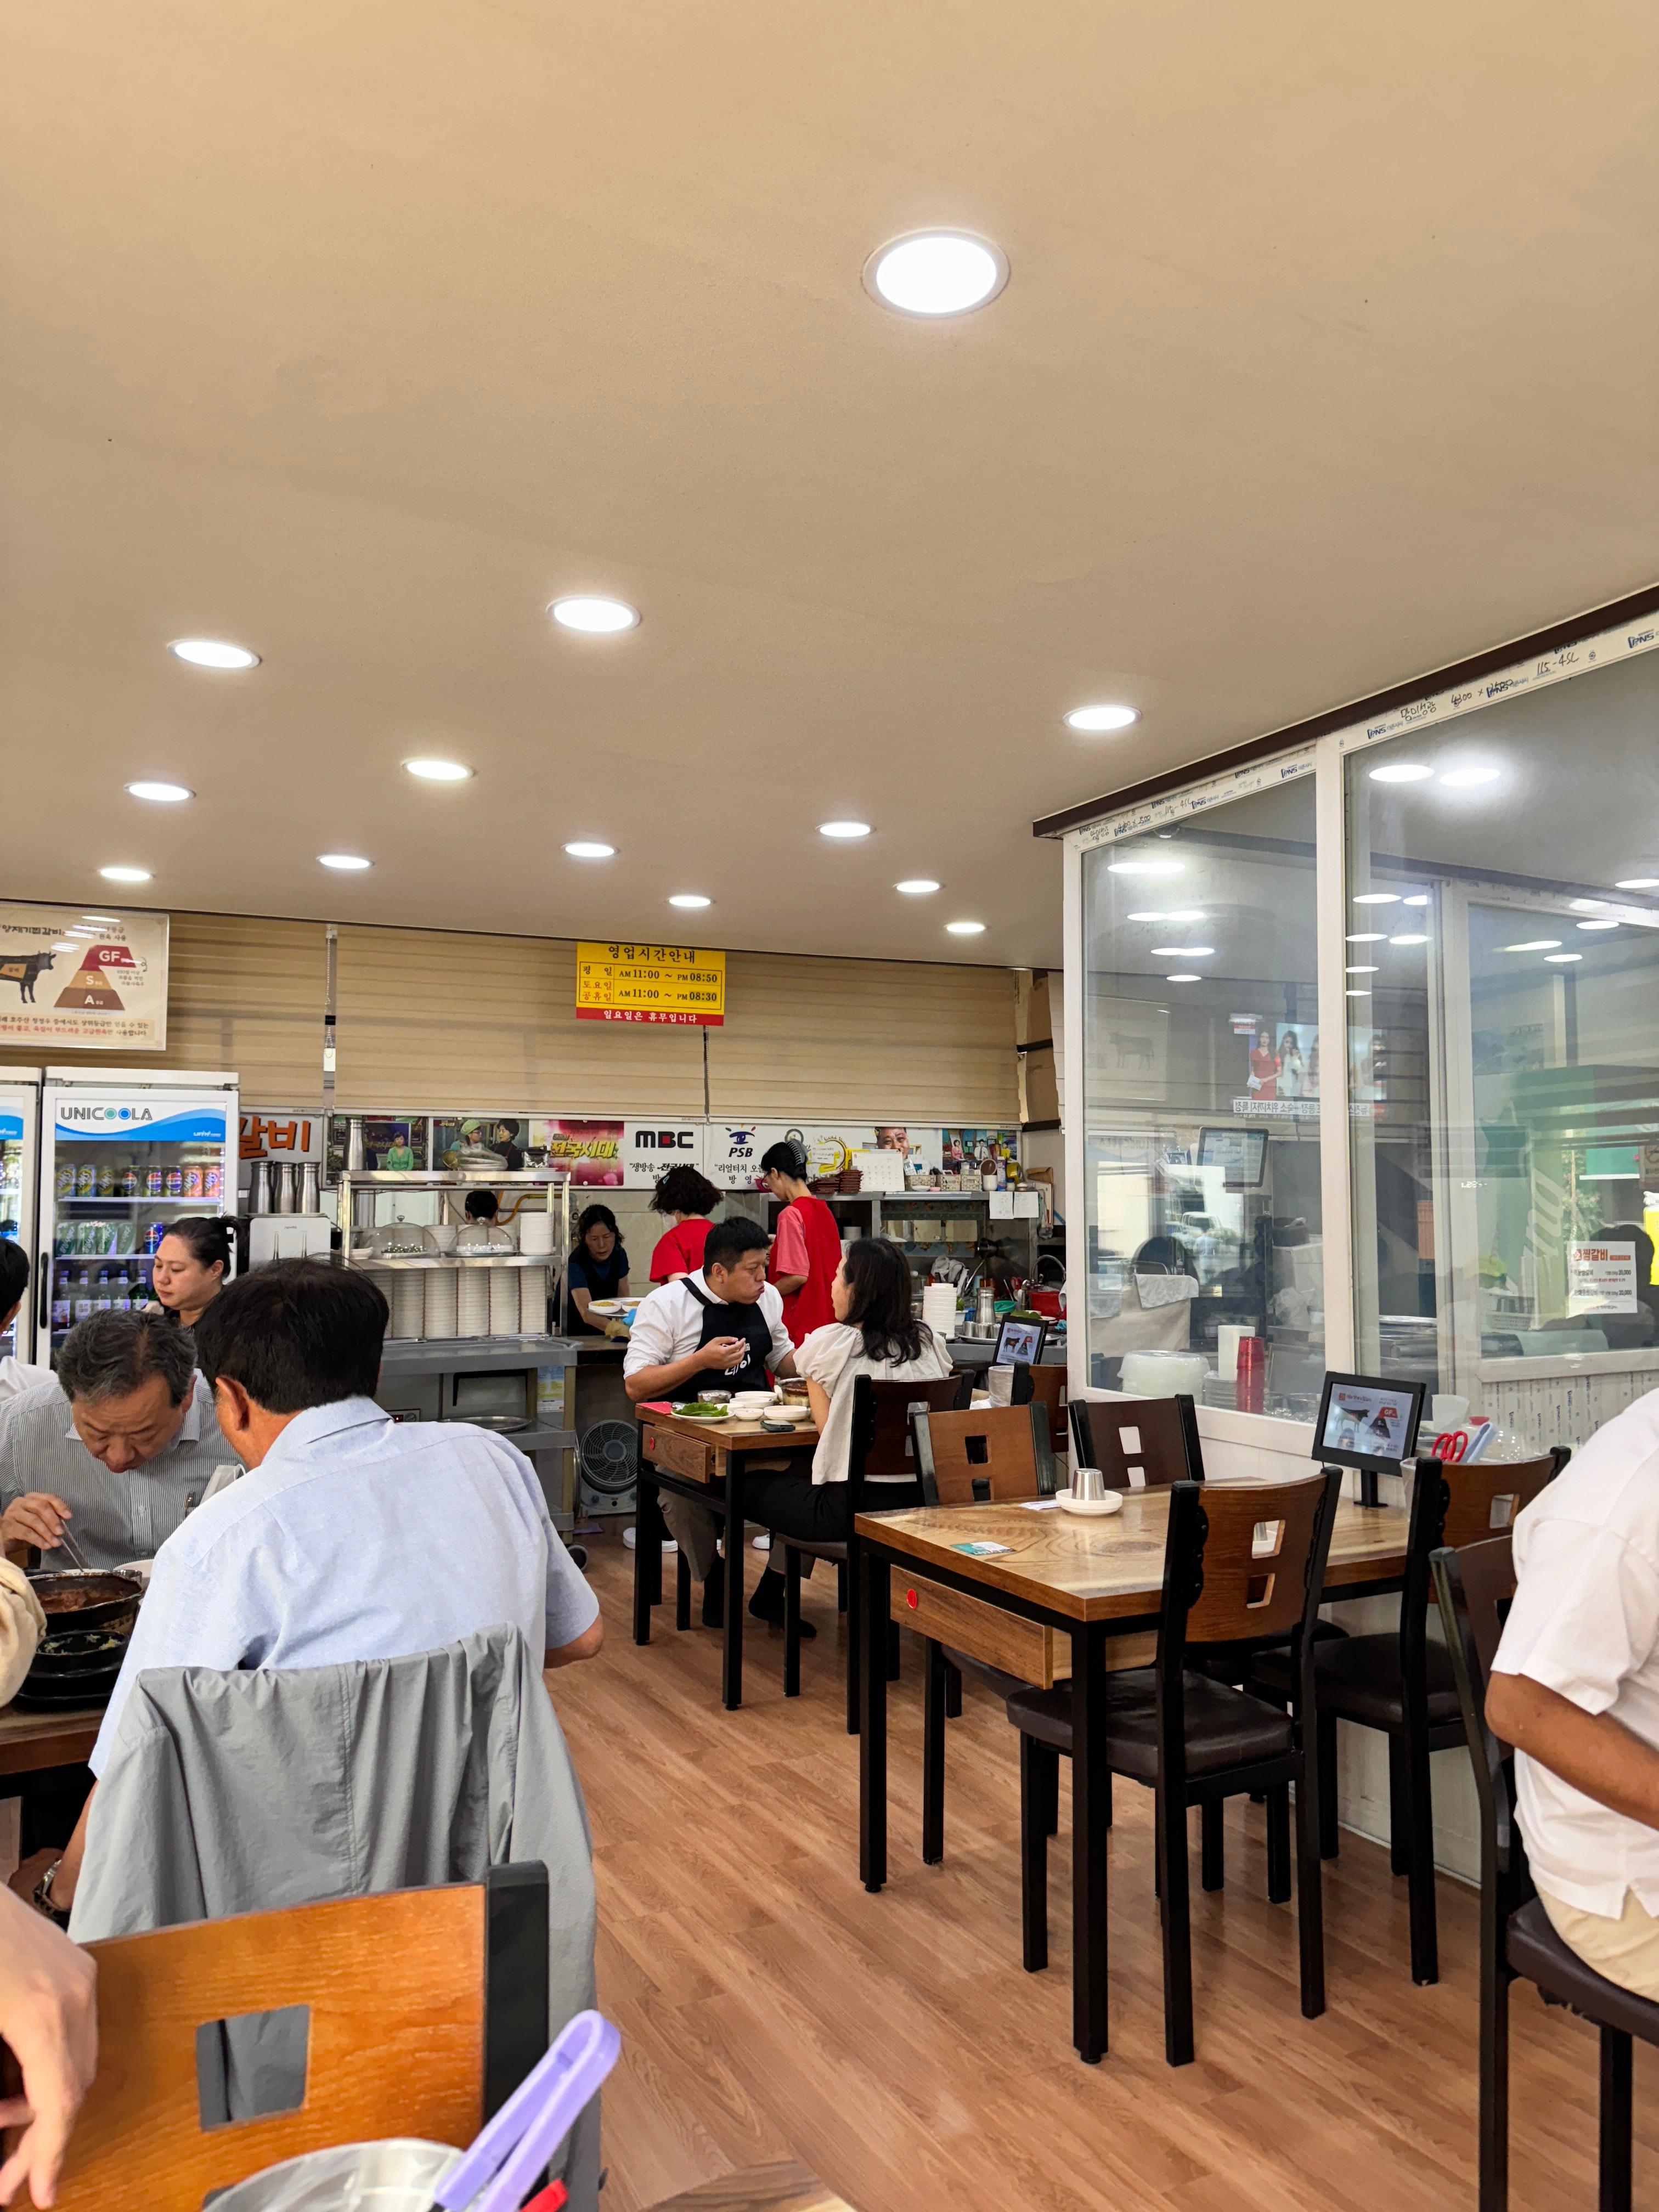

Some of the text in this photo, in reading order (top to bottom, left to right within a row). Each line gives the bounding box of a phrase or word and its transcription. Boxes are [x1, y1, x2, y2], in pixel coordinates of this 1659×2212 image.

[99, 950, 120, 962] GF
[608, 945, 695, 964] 영업시간안내
[86, 975, 94, 985] S
[633, 969, 660, 979] 11:00
[690, 973, 718, 983] 08:50
[84, 995, 95, 1005] A
[633, 989, 659, 998] 11:00
[689, 991, 717, 1001] 08:30
[603, 1010, 697, 1024] 일요일은 휴무입니다
[635, 1131, 694, 1149] MBC
[729, 1147, 753, 1157] PSB
